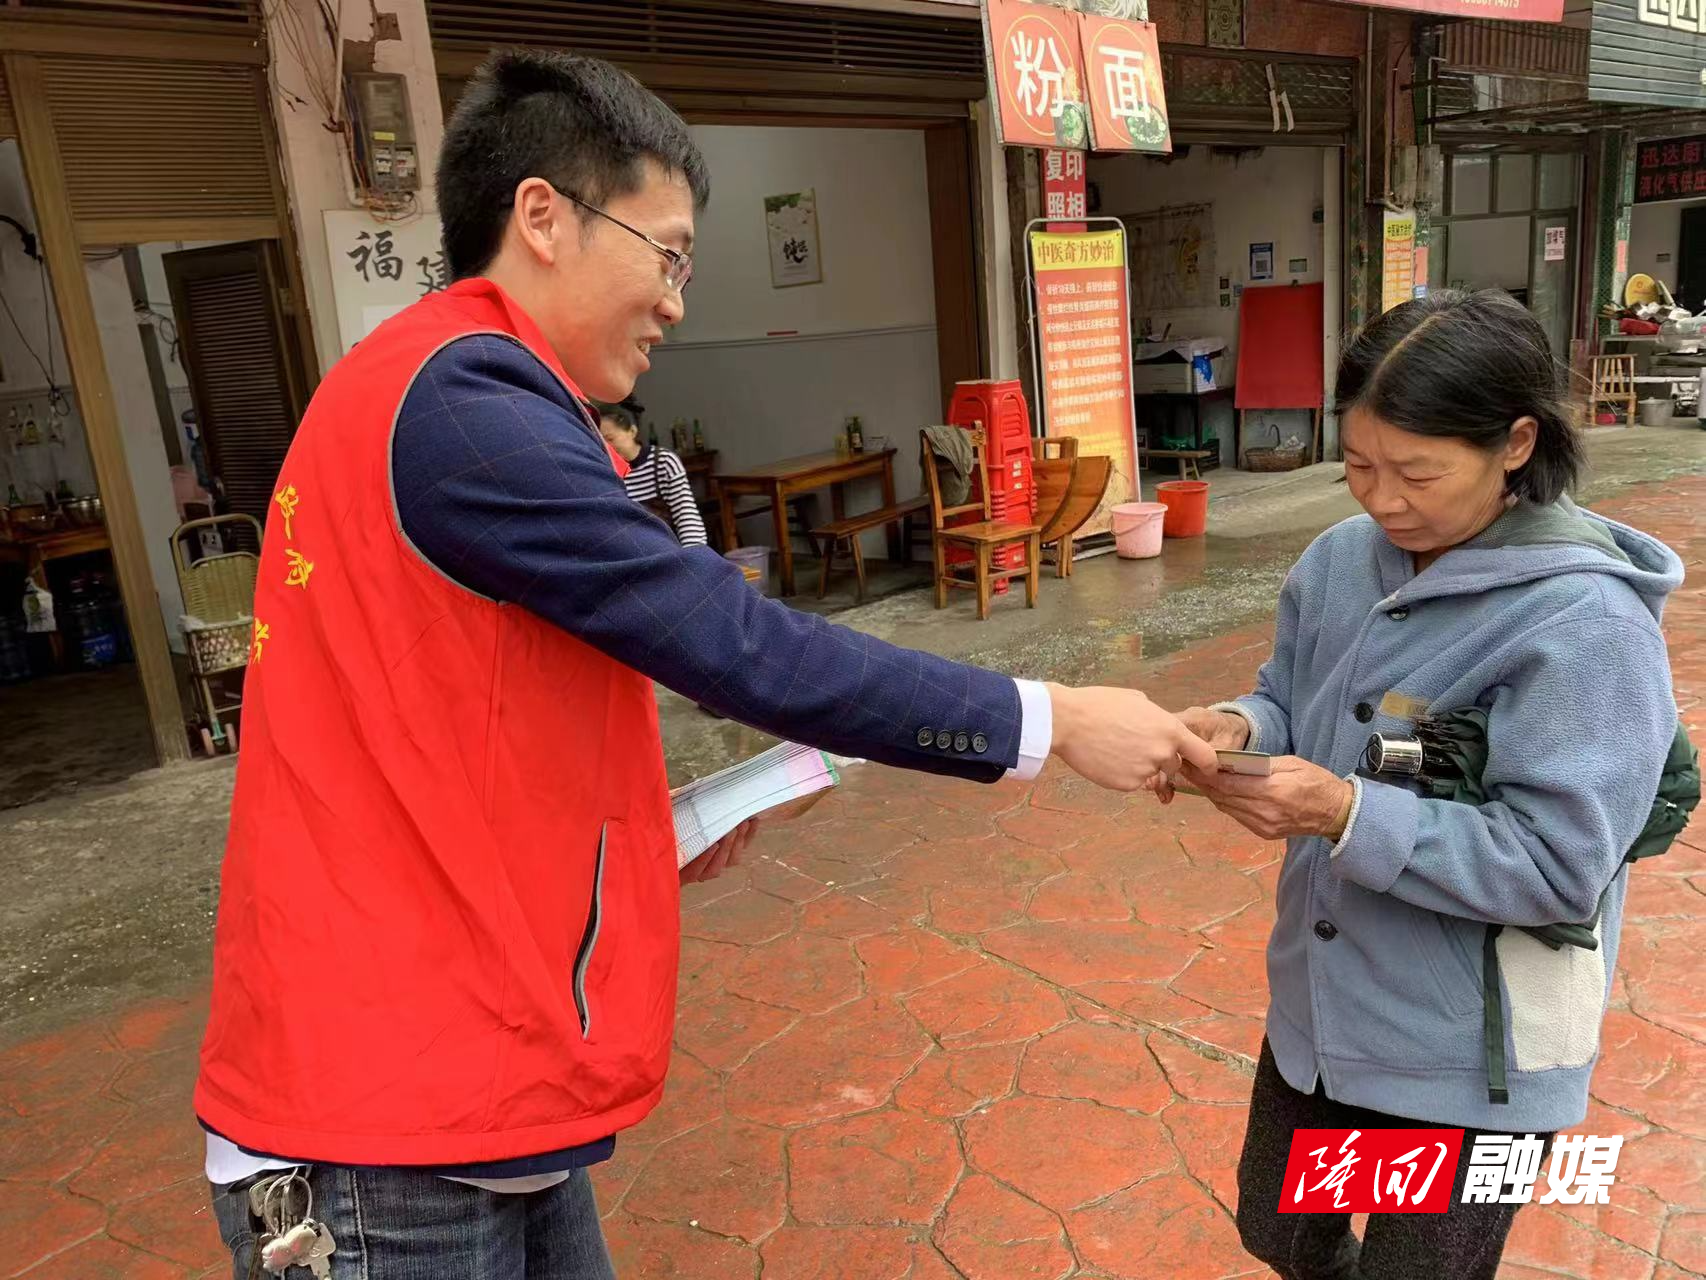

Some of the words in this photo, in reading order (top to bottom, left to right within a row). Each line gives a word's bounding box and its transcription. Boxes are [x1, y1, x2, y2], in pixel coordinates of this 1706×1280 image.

[1010, 31, 1067, 117] 粉
[1098, 45, 1152, 123] 面
[1046, 150, 1083, 181] 复印
[1641, 141, 1706, 168] 迅达厨
[1047, 191, 1085, 219] 照相
[1037, 241, 1115, 264] 中医奇方妙治
